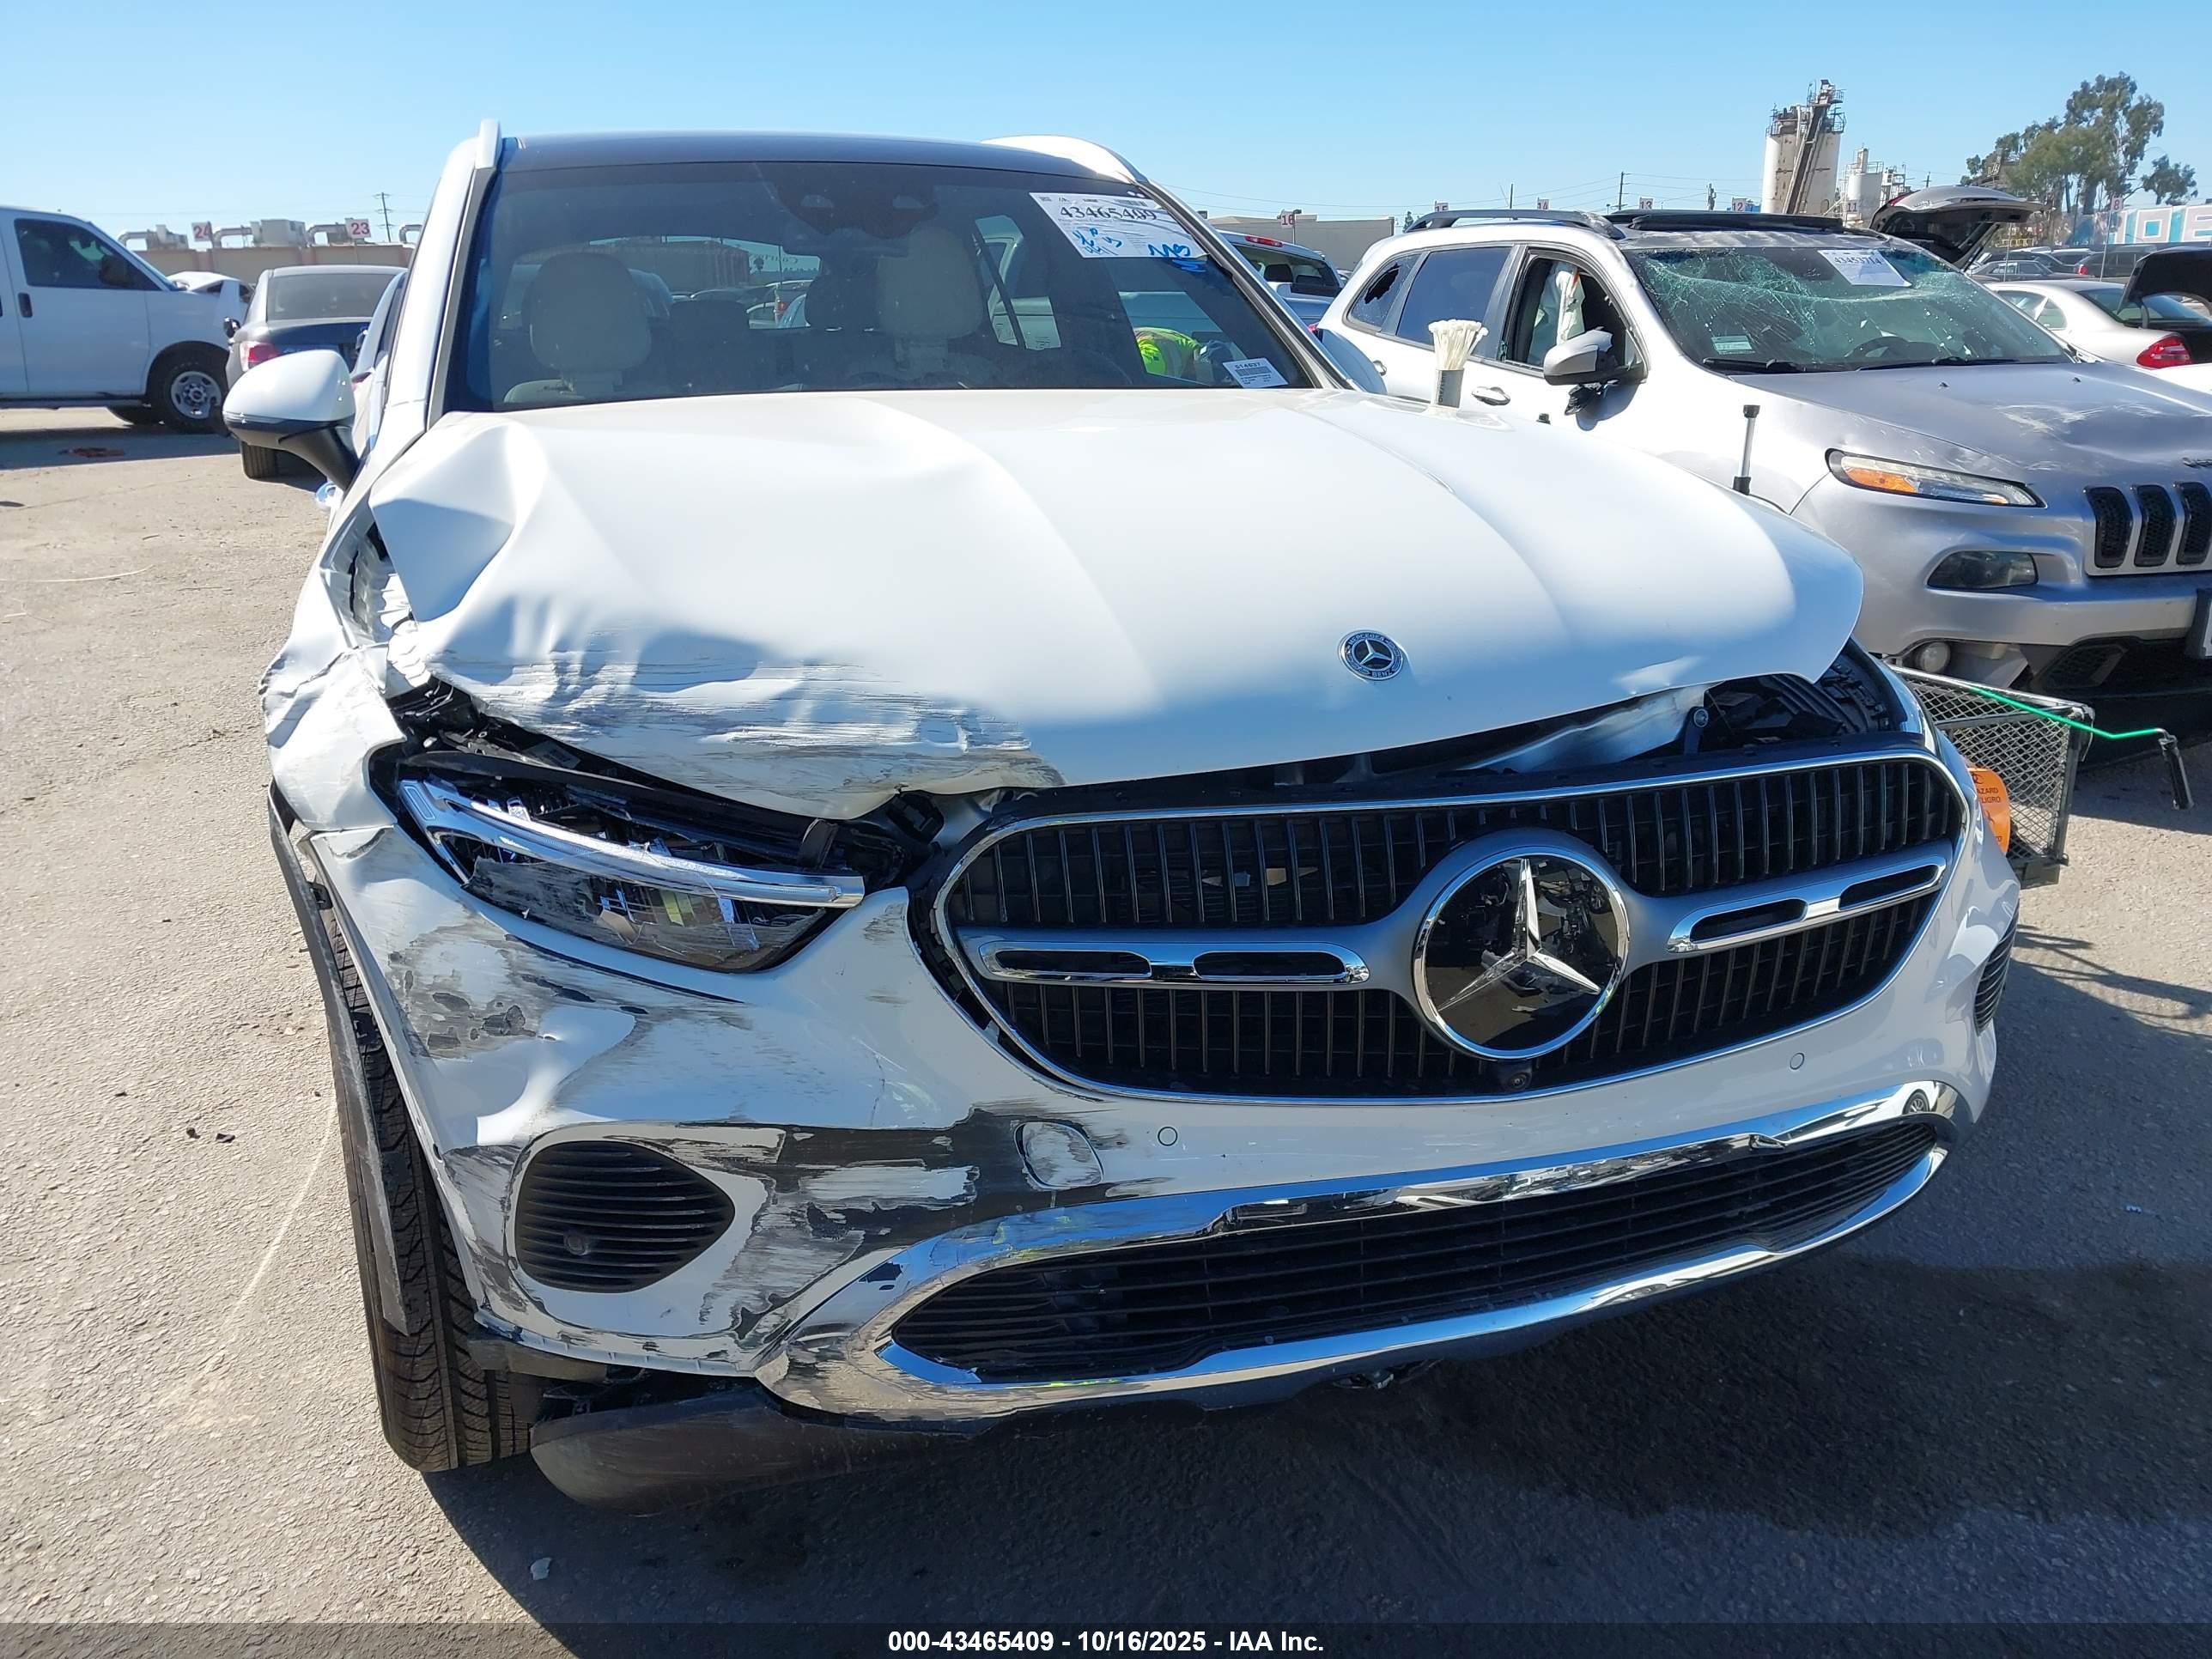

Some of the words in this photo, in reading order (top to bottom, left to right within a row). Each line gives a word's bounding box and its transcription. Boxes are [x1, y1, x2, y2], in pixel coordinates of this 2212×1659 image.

[1640, 201, 1653, 210] 13
[1732, 201, 1744, 211] 12
[1847, 203, 1857, 211] 11
[1282, 214, 1296, 226] 16
[193, 225, 210, 239] 24
[350, 222, 369, 235] 23
[1834, 257, 1882, 265] 43453714
[1371, 669, 1393, 678] BENZ
